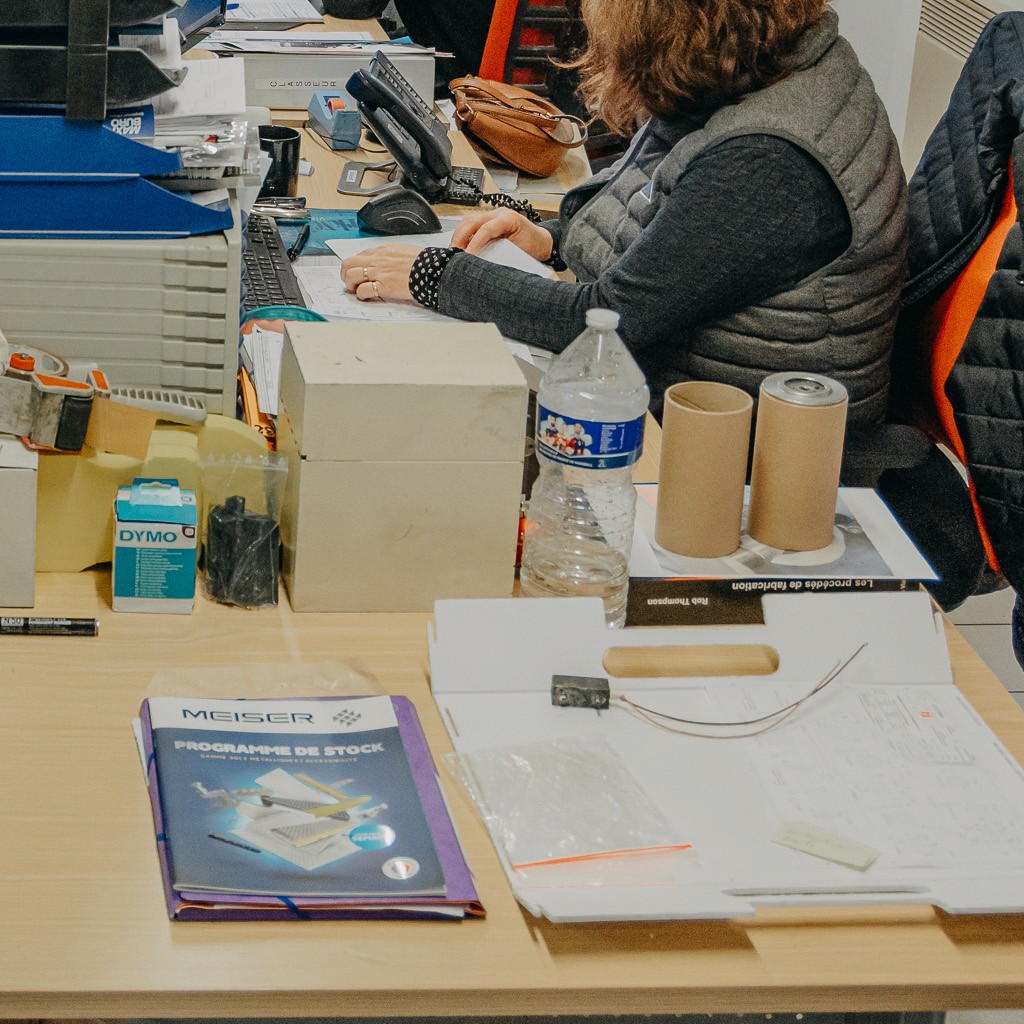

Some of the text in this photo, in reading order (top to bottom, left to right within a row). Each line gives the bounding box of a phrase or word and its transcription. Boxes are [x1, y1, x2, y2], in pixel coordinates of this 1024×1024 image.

[110, 117, 142, 127] BURO
[119, 529, 178, 543] DYMO
[731, 578, 873, 592] Les procédés de fabrication
[647, 597, 709, 607] Rob Thompson
[182, 709, 315, 725] MEISER
[174, 741, 386, 757] PROGRAMME DE STOCK
